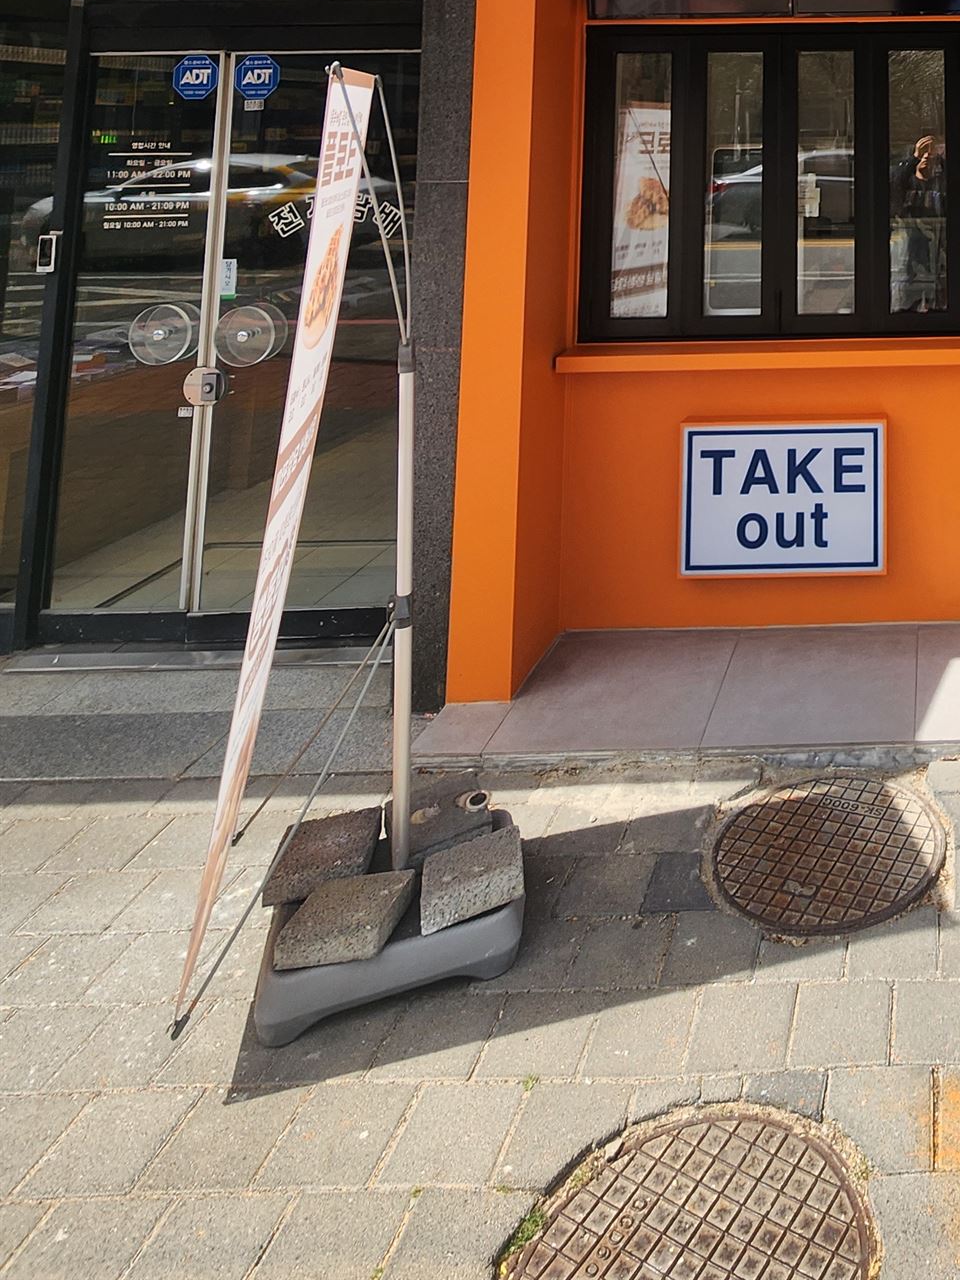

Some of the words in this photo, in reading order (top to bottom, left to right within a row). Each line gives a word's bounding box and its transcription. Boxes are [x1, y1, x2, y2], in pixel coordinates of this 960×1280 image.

[180, 68, 212, 85] ADT
[241, 68, 273, 85] ADT
[177, 170, 191, 178] PM
[130, 202, 144, 210] AM
[700, 448, 866, 496] TAKE
[736, 503, 829, 549] out
[823, 797, 885, 817] SK-600G
